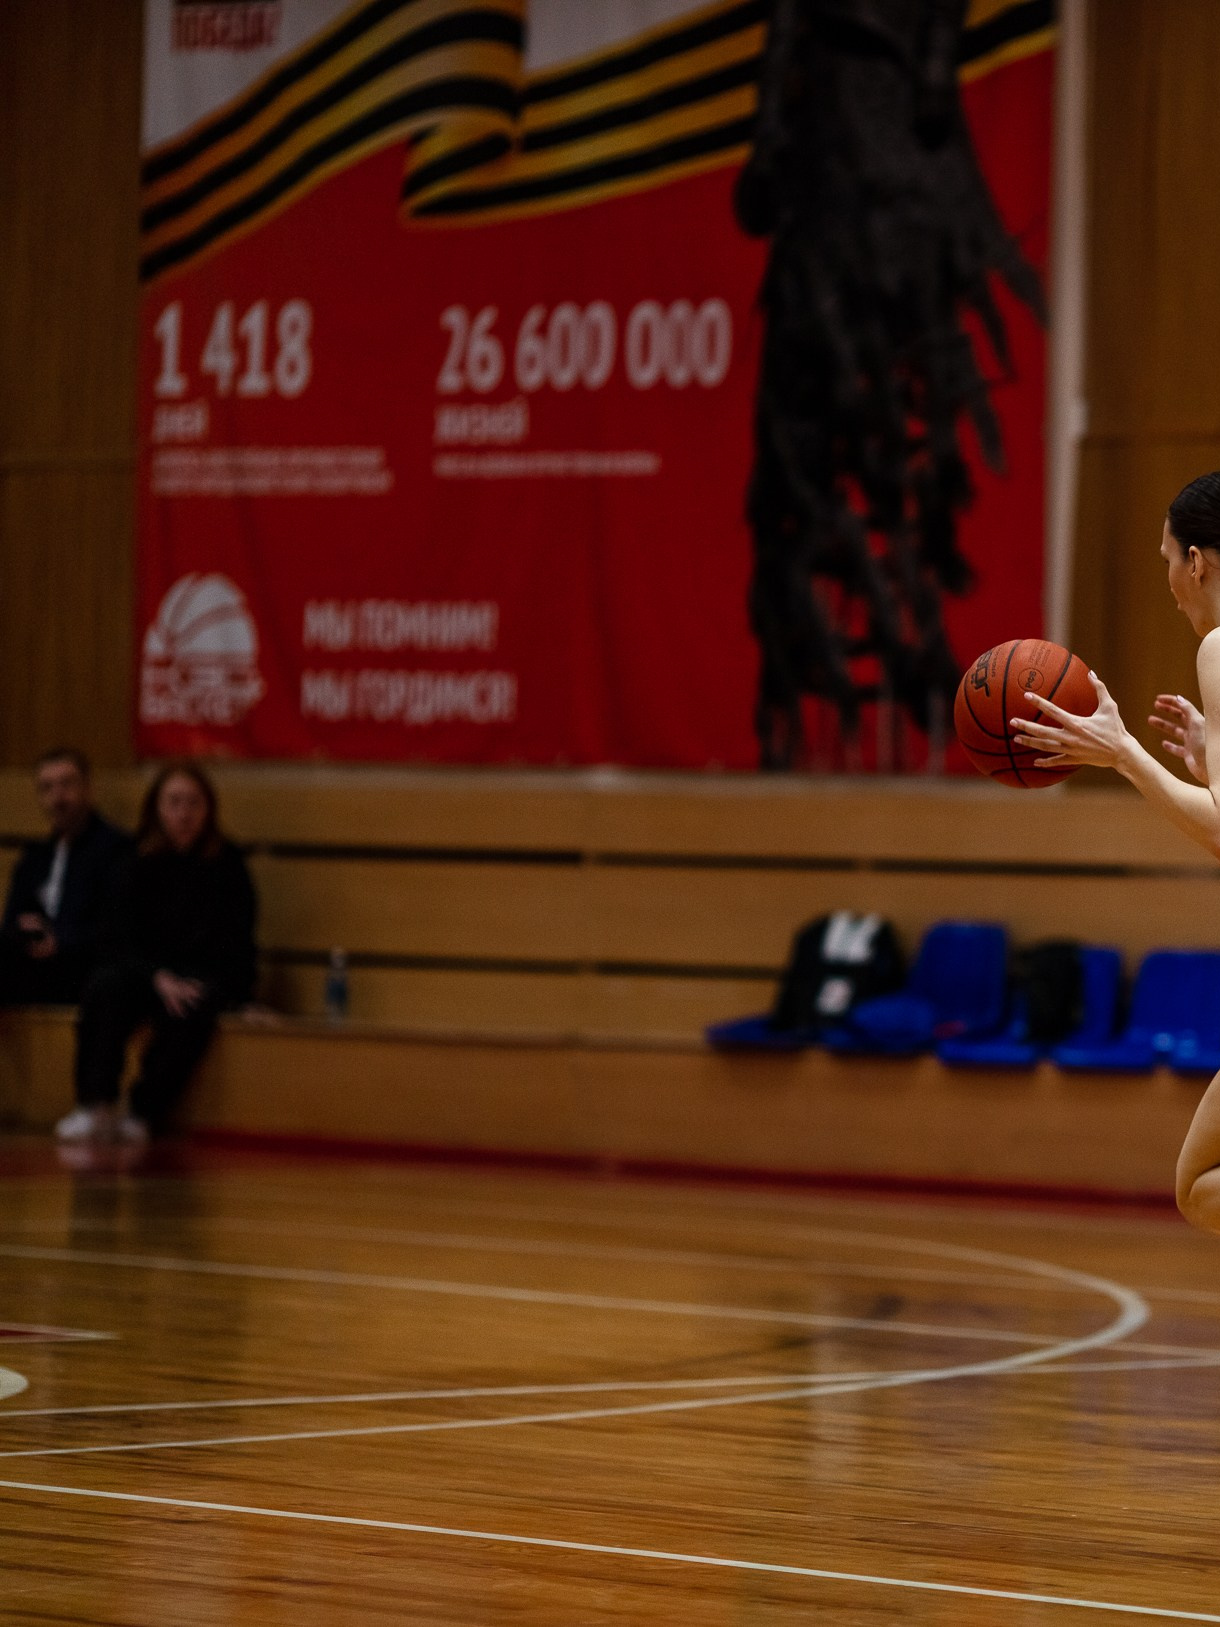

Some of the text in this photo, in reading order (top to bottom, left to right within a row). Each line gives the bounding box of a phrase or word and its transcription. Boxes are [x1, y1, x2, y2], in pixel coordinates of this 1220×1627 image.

[153, 298, 312, 398] 1 418
[436, 298, 733, 394] 26 600 000
